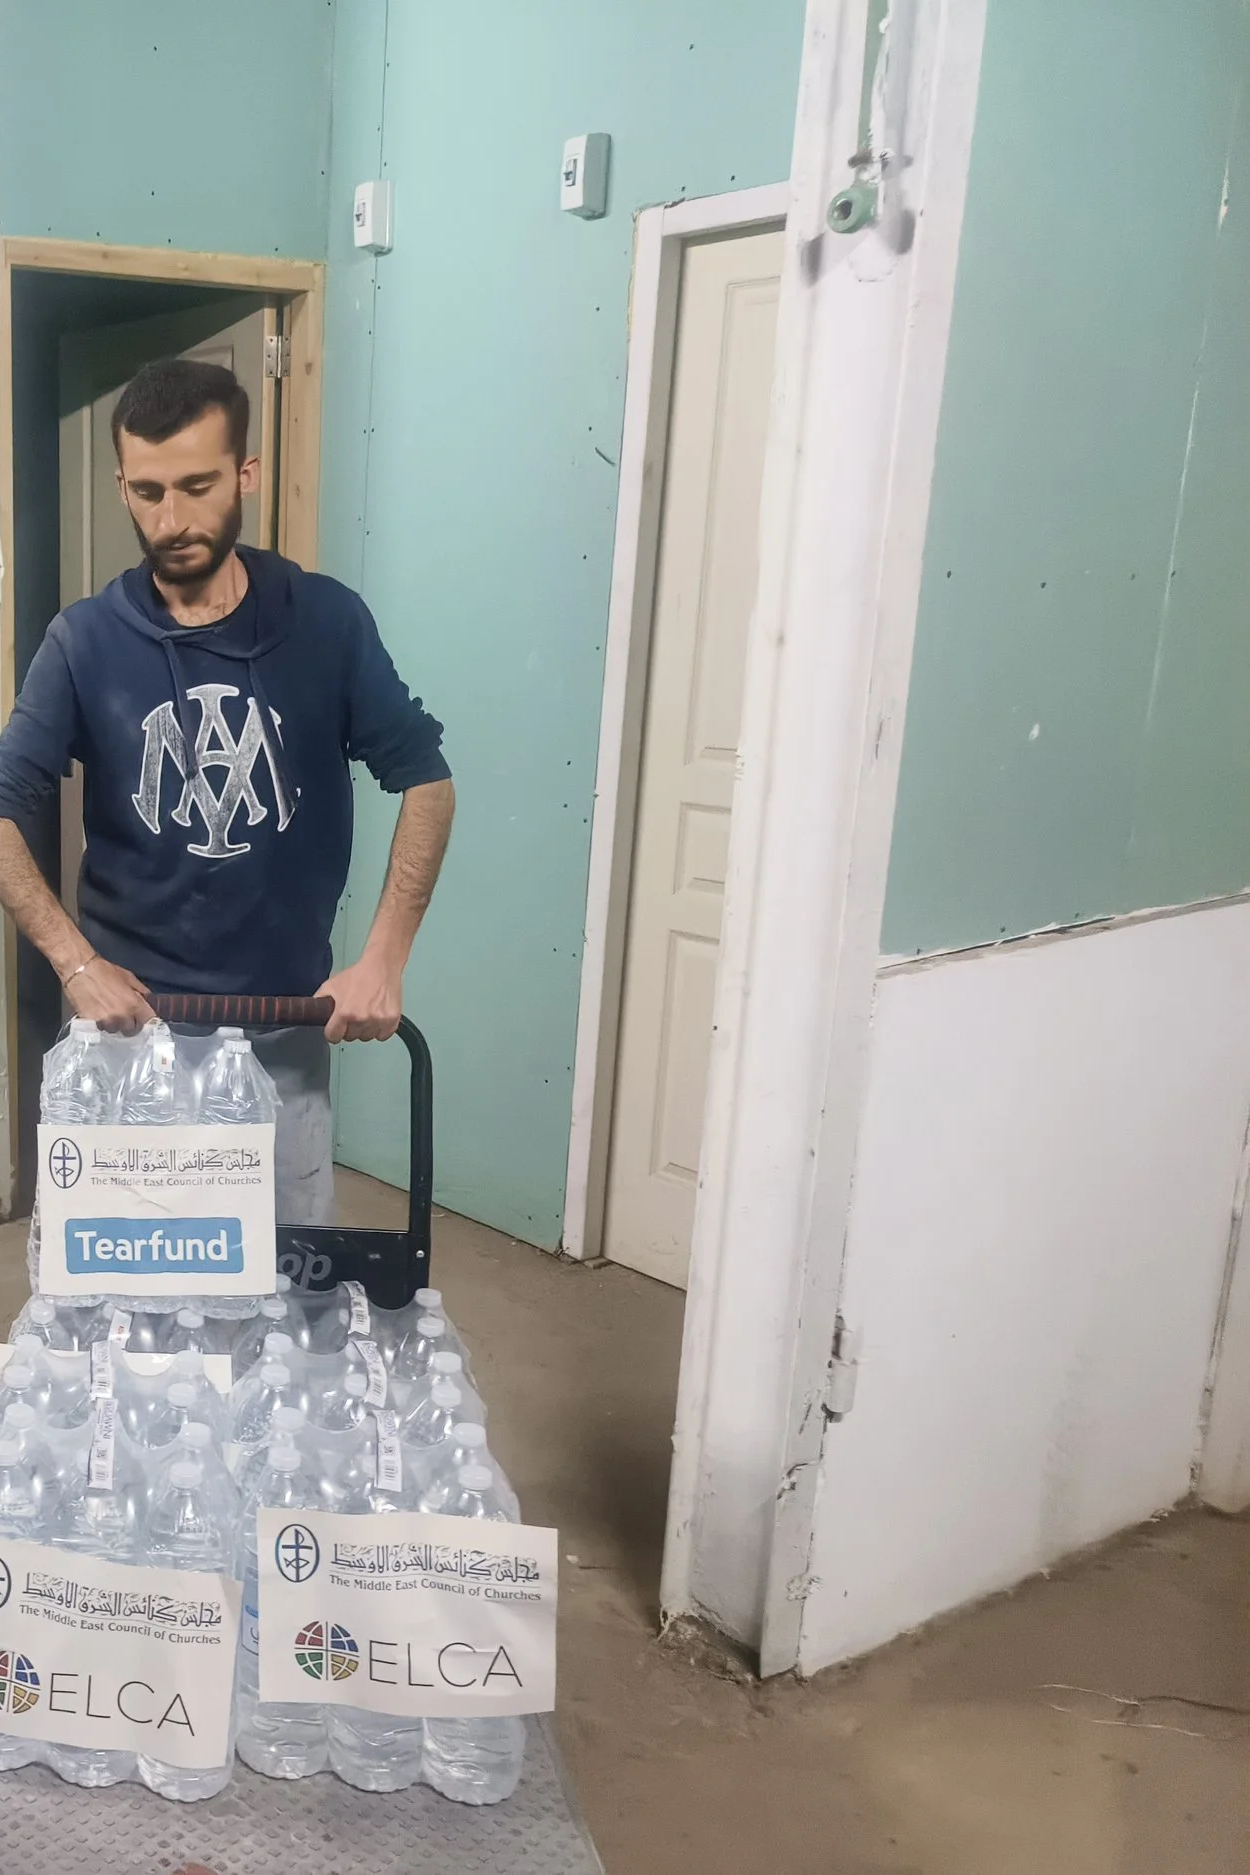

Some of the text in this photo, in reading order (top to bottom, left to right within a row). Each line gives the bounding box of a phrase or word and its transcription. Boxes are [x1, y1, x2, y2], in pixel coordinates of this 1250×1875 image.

[91, 1176, 262, 1187] The Middle East Council of Churches
[74, 1229, 229, 1262] Tearfund
[329, 1575, 542, 1601] The Middle East Council of Churches
[19, 1604, 221, 1645] The Middle East Council of Churches
[369, 1639, 523, 1688] ELCA
[49, 1672, 196, 1737] ELCA
